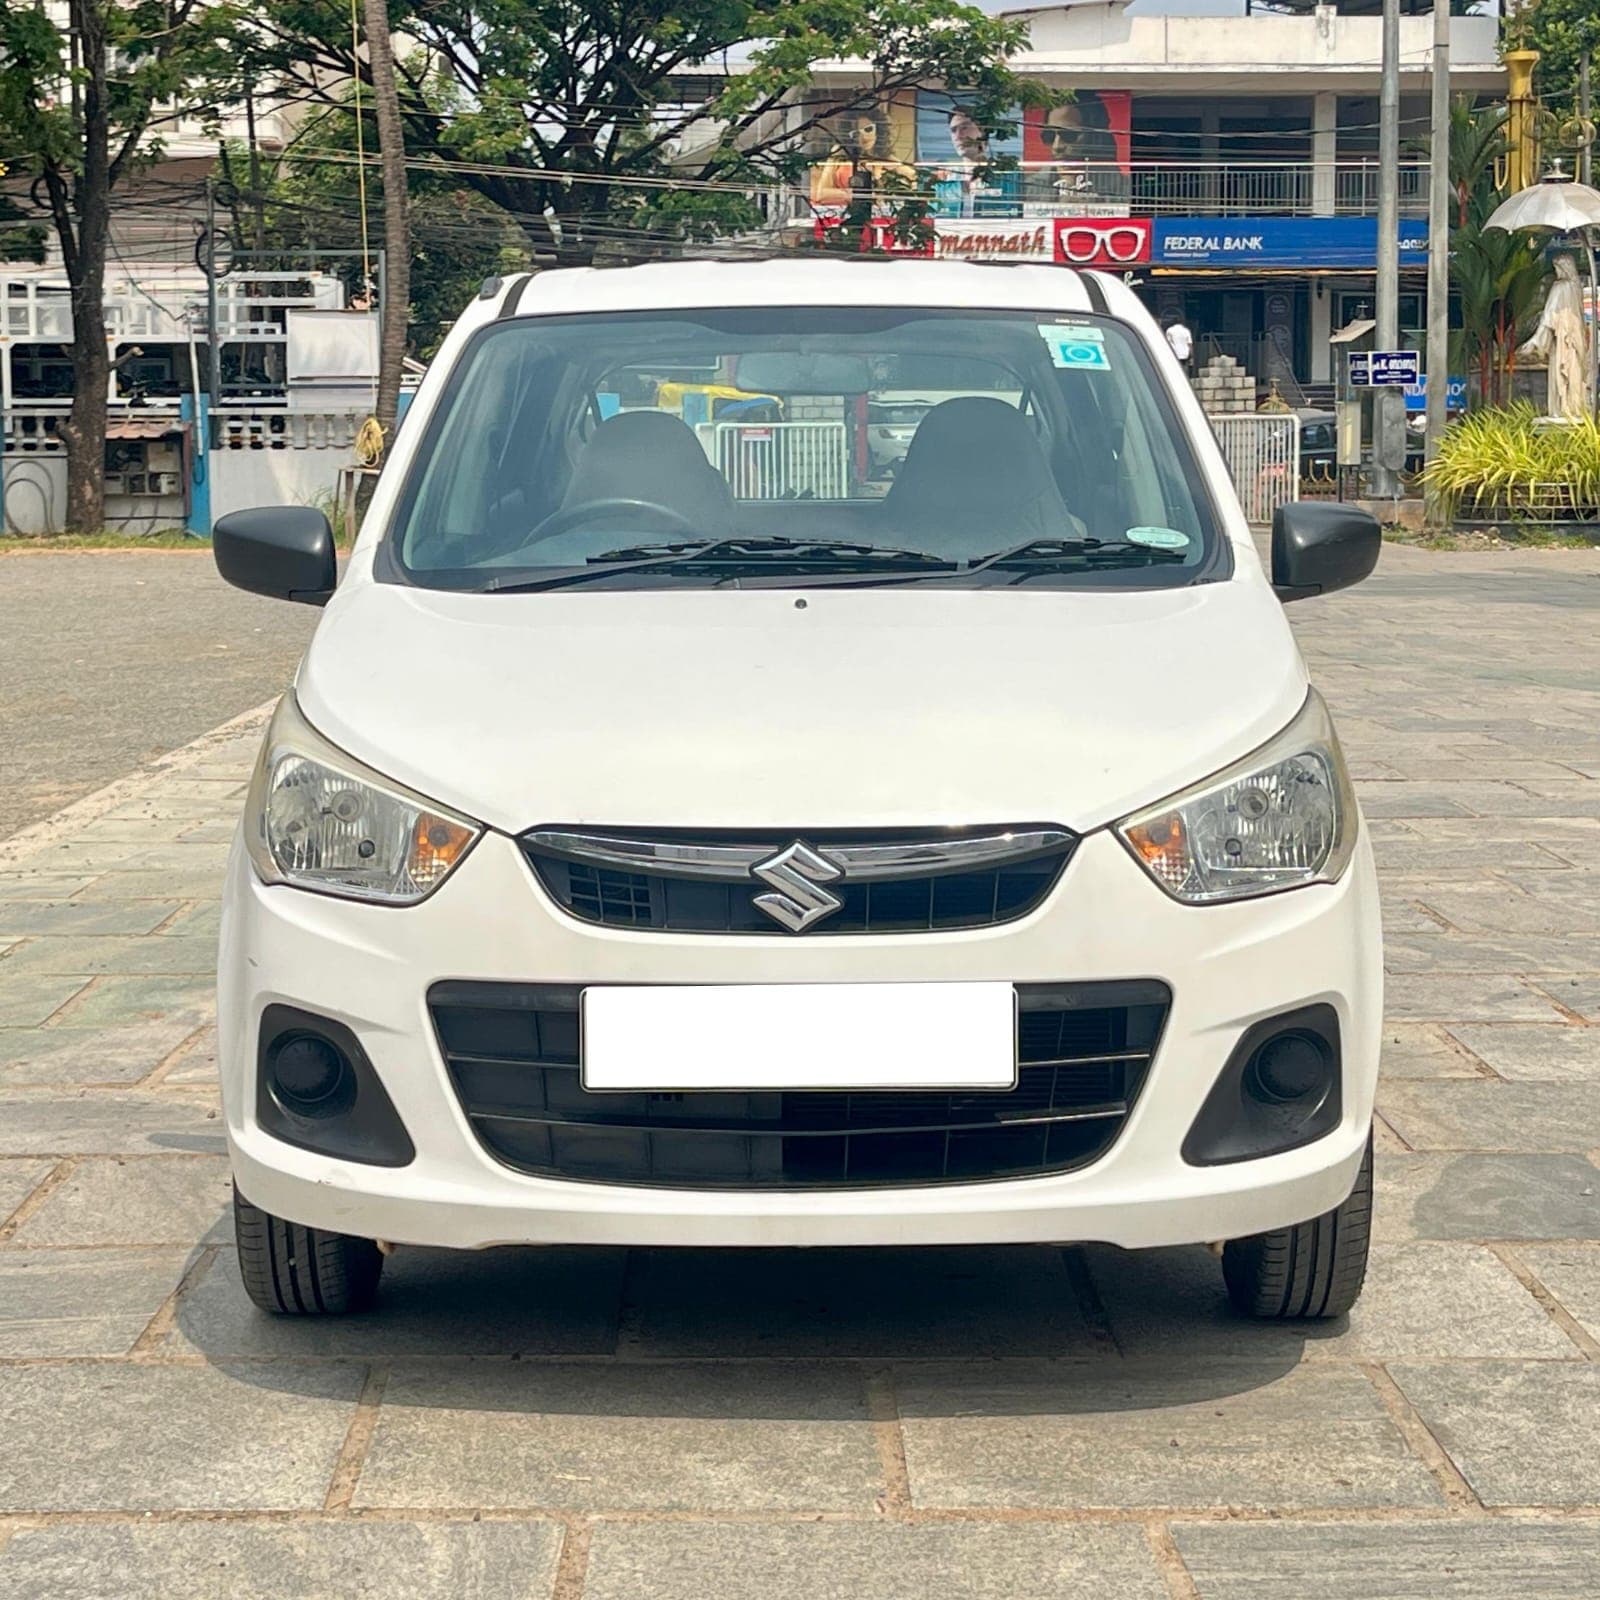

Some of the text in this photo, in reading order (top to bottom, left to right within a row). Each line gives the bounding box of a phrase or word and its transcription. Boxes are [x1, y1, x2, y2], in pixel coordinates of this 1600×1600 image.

[939, 226, 1046, 255] mannath
[1164, 236, 1263, 250] FEDERAL BANK
